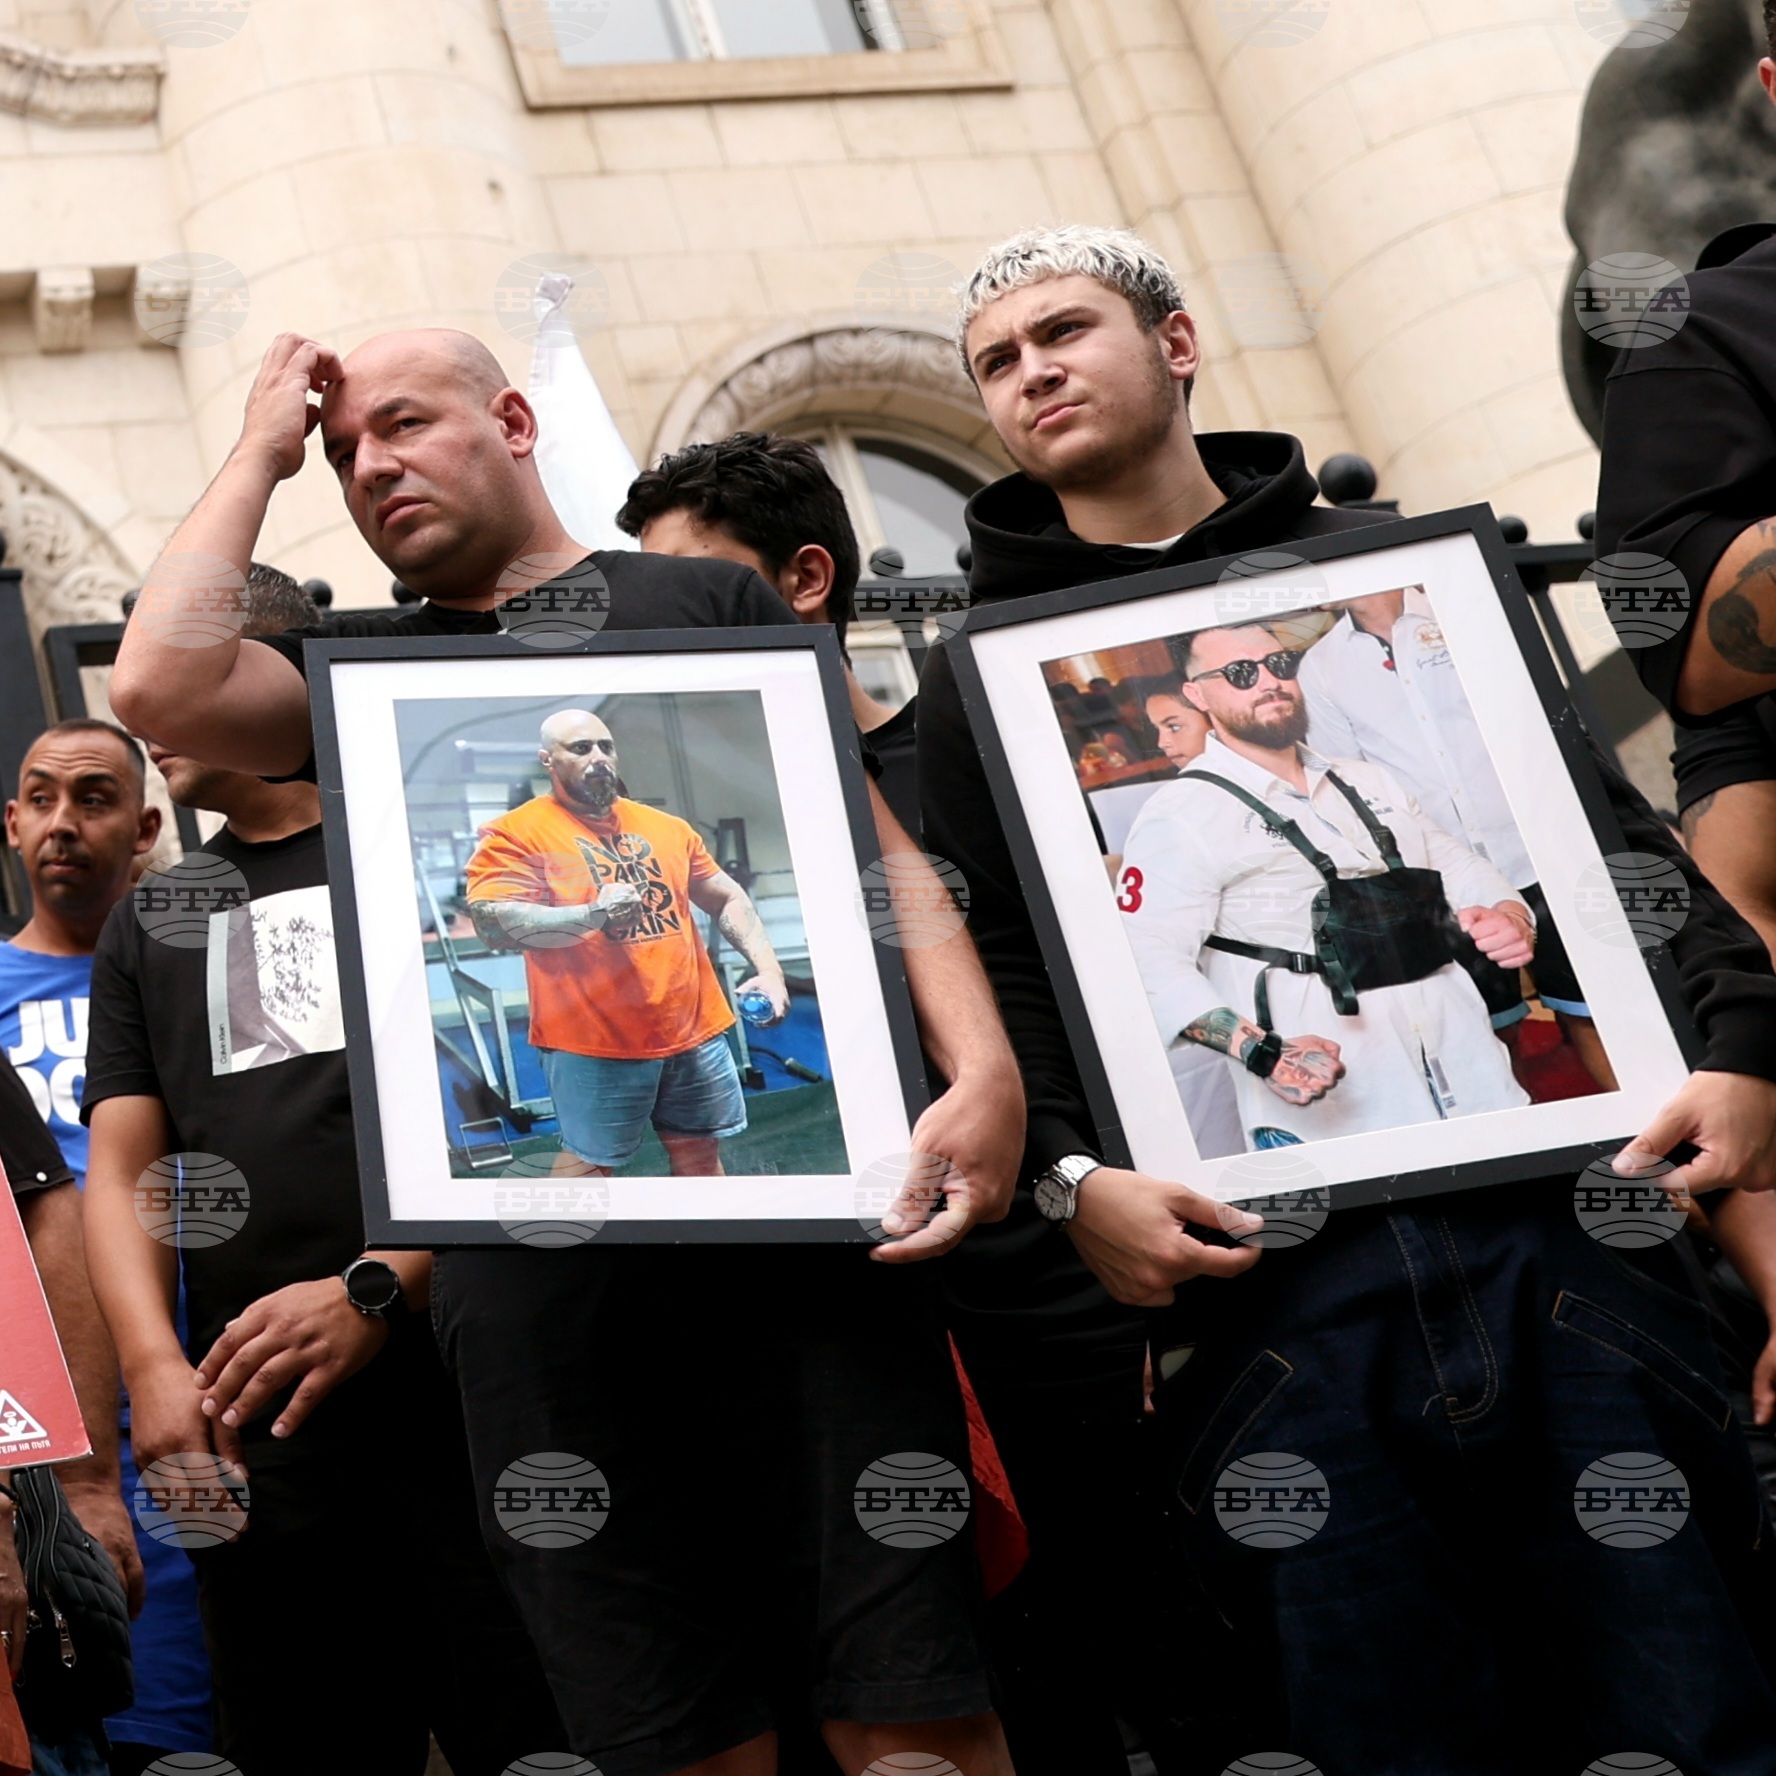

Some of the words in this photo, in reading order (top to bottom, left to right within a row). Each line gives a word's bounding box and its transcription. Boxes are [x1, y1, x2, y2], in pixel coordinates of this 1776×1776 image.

[575, 833, 651, 863] NO
[589, 858, 662, 892] PAIN
[1116, 866, 1143, 913] 3
